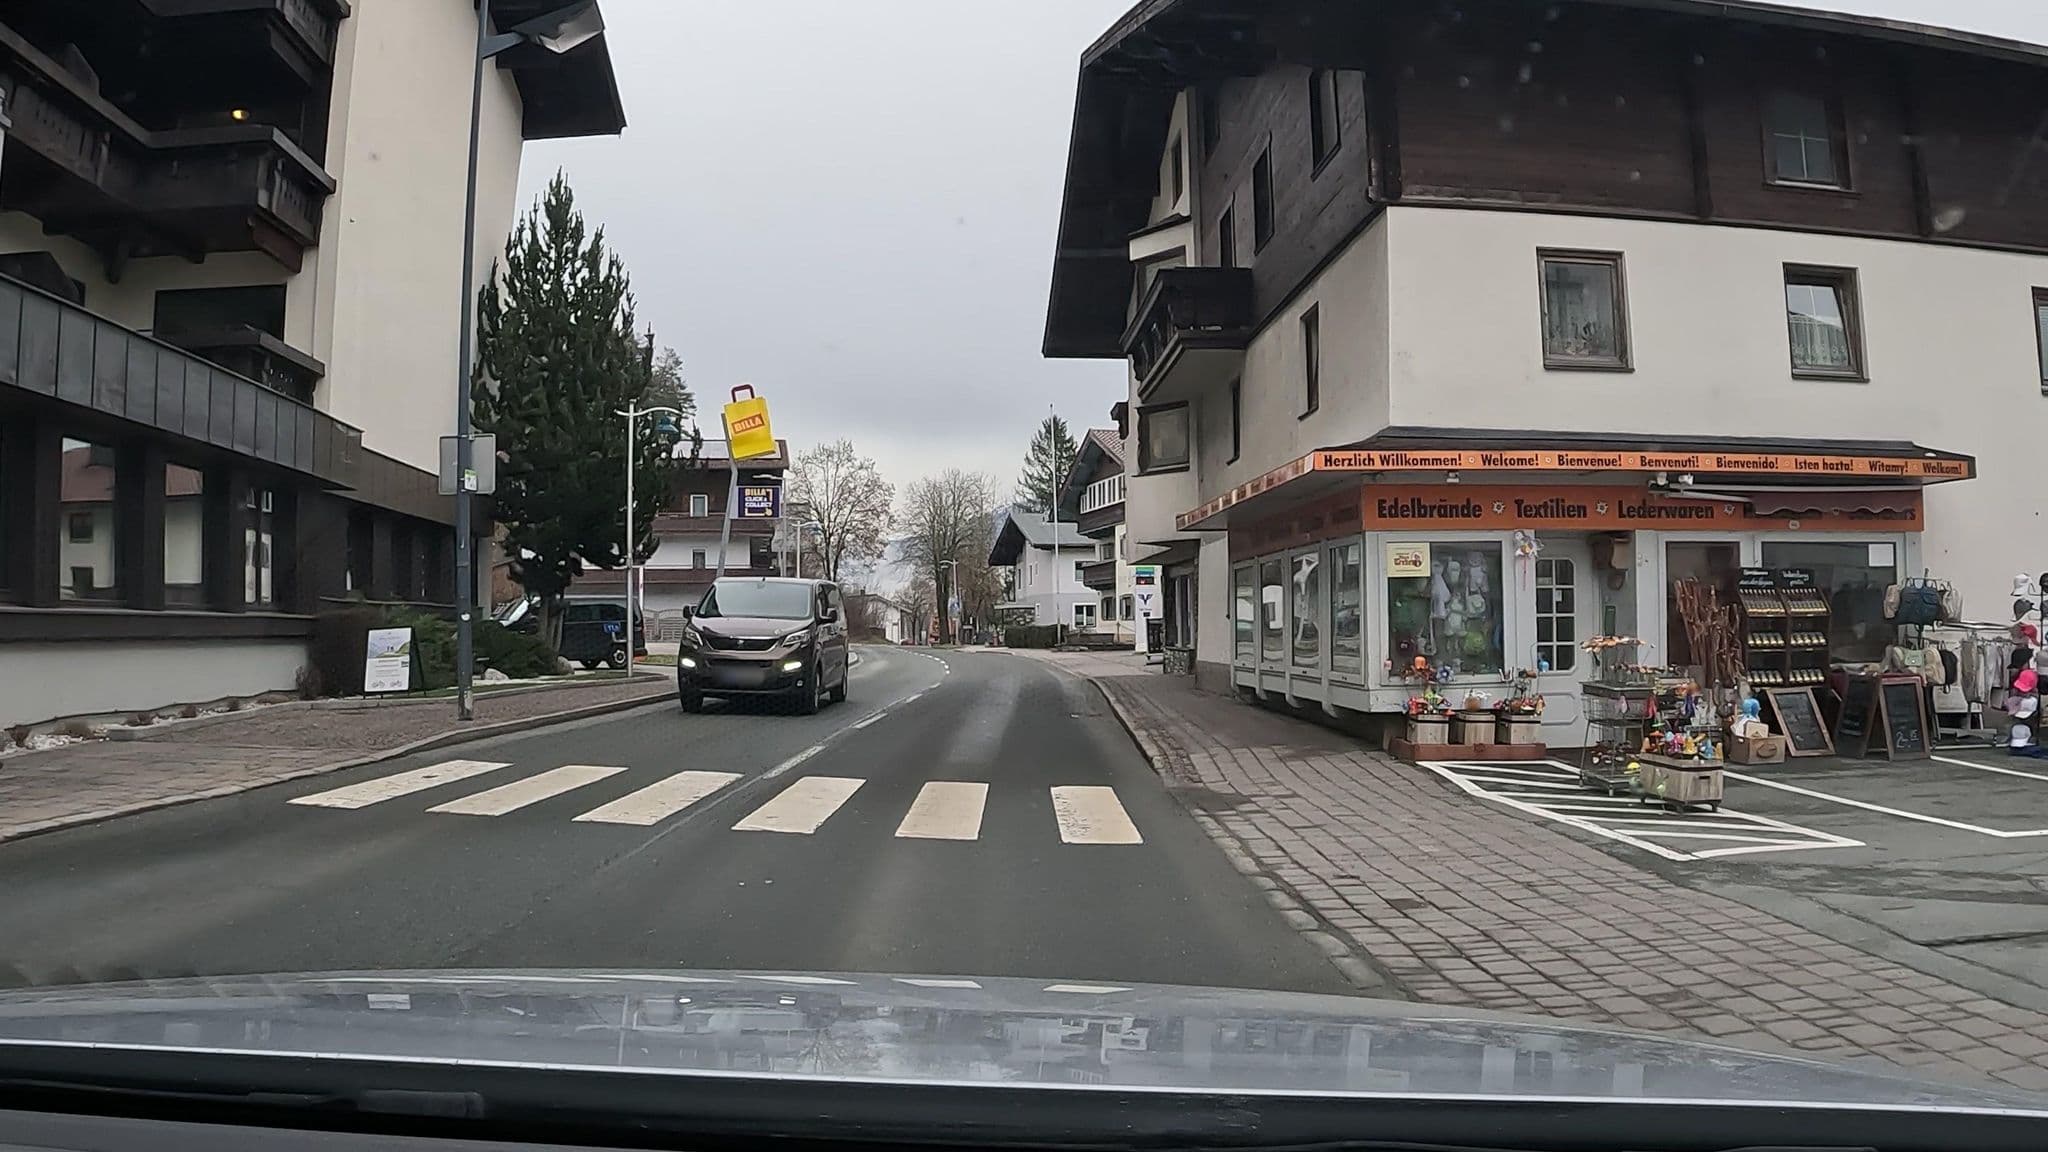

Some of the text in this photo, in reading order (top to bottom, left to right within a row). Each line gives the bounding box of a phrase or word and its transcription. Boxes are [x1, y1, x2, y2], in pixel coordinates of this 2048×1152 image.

[733, 416, 763, 432] BILLA
[1324, 454, 1375, 467] Herzlich
[1379, 454, 1462, 467] Willkommen!
[1481, 454, 1539, 466] Welcome!
[1557, 454, 1622, 467] Bienvenue!
[1640, 456, 1699, 468] Benvenuti!
[1716, 457, 1779, 469] Bienvenido!
[1794, 458, 1820, 470] Isten
[1868, 460, 1908, 475] Witamy!
[1922, 462, 1962, 475] Welkom!
[1377, 498, 1714, 519] Edelbrände Textilien Lederwaren
